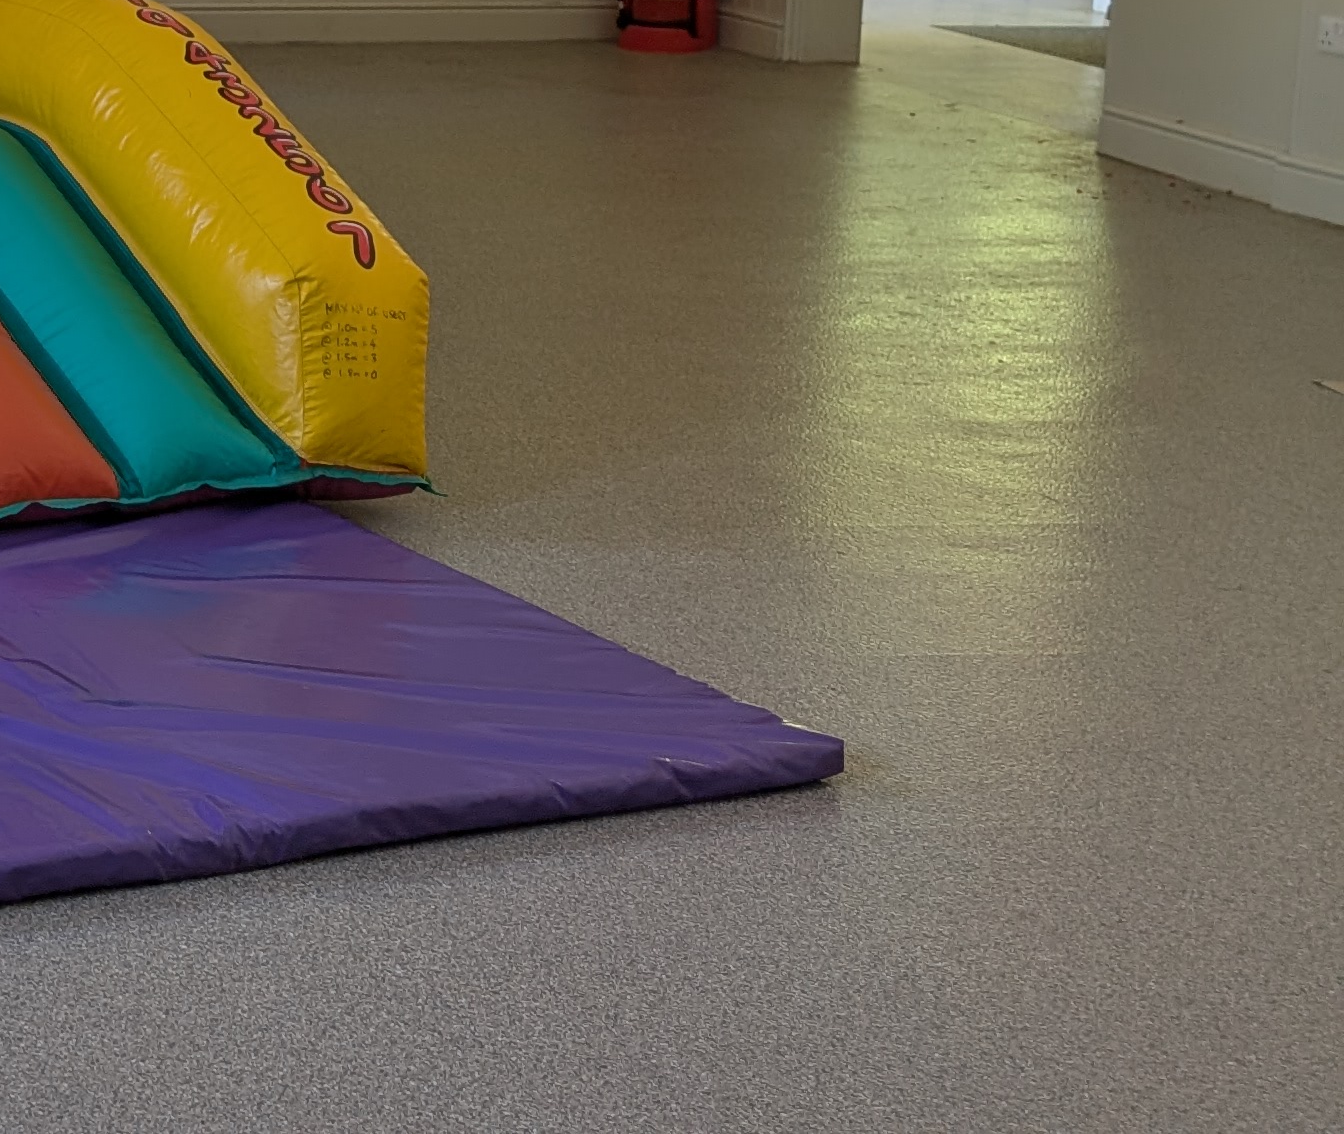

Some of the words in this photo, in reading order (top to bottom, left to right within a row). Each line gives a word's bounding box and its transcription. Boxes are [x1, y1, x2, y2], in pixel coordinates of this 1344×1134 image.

[325, 303, 347, 315] MAX
[367, 307, 378, 317] OF
[371, 324, 378, 335] 5
[336, 337, 358, 347] 1.2m
[370, 338, 376, 350] 4
